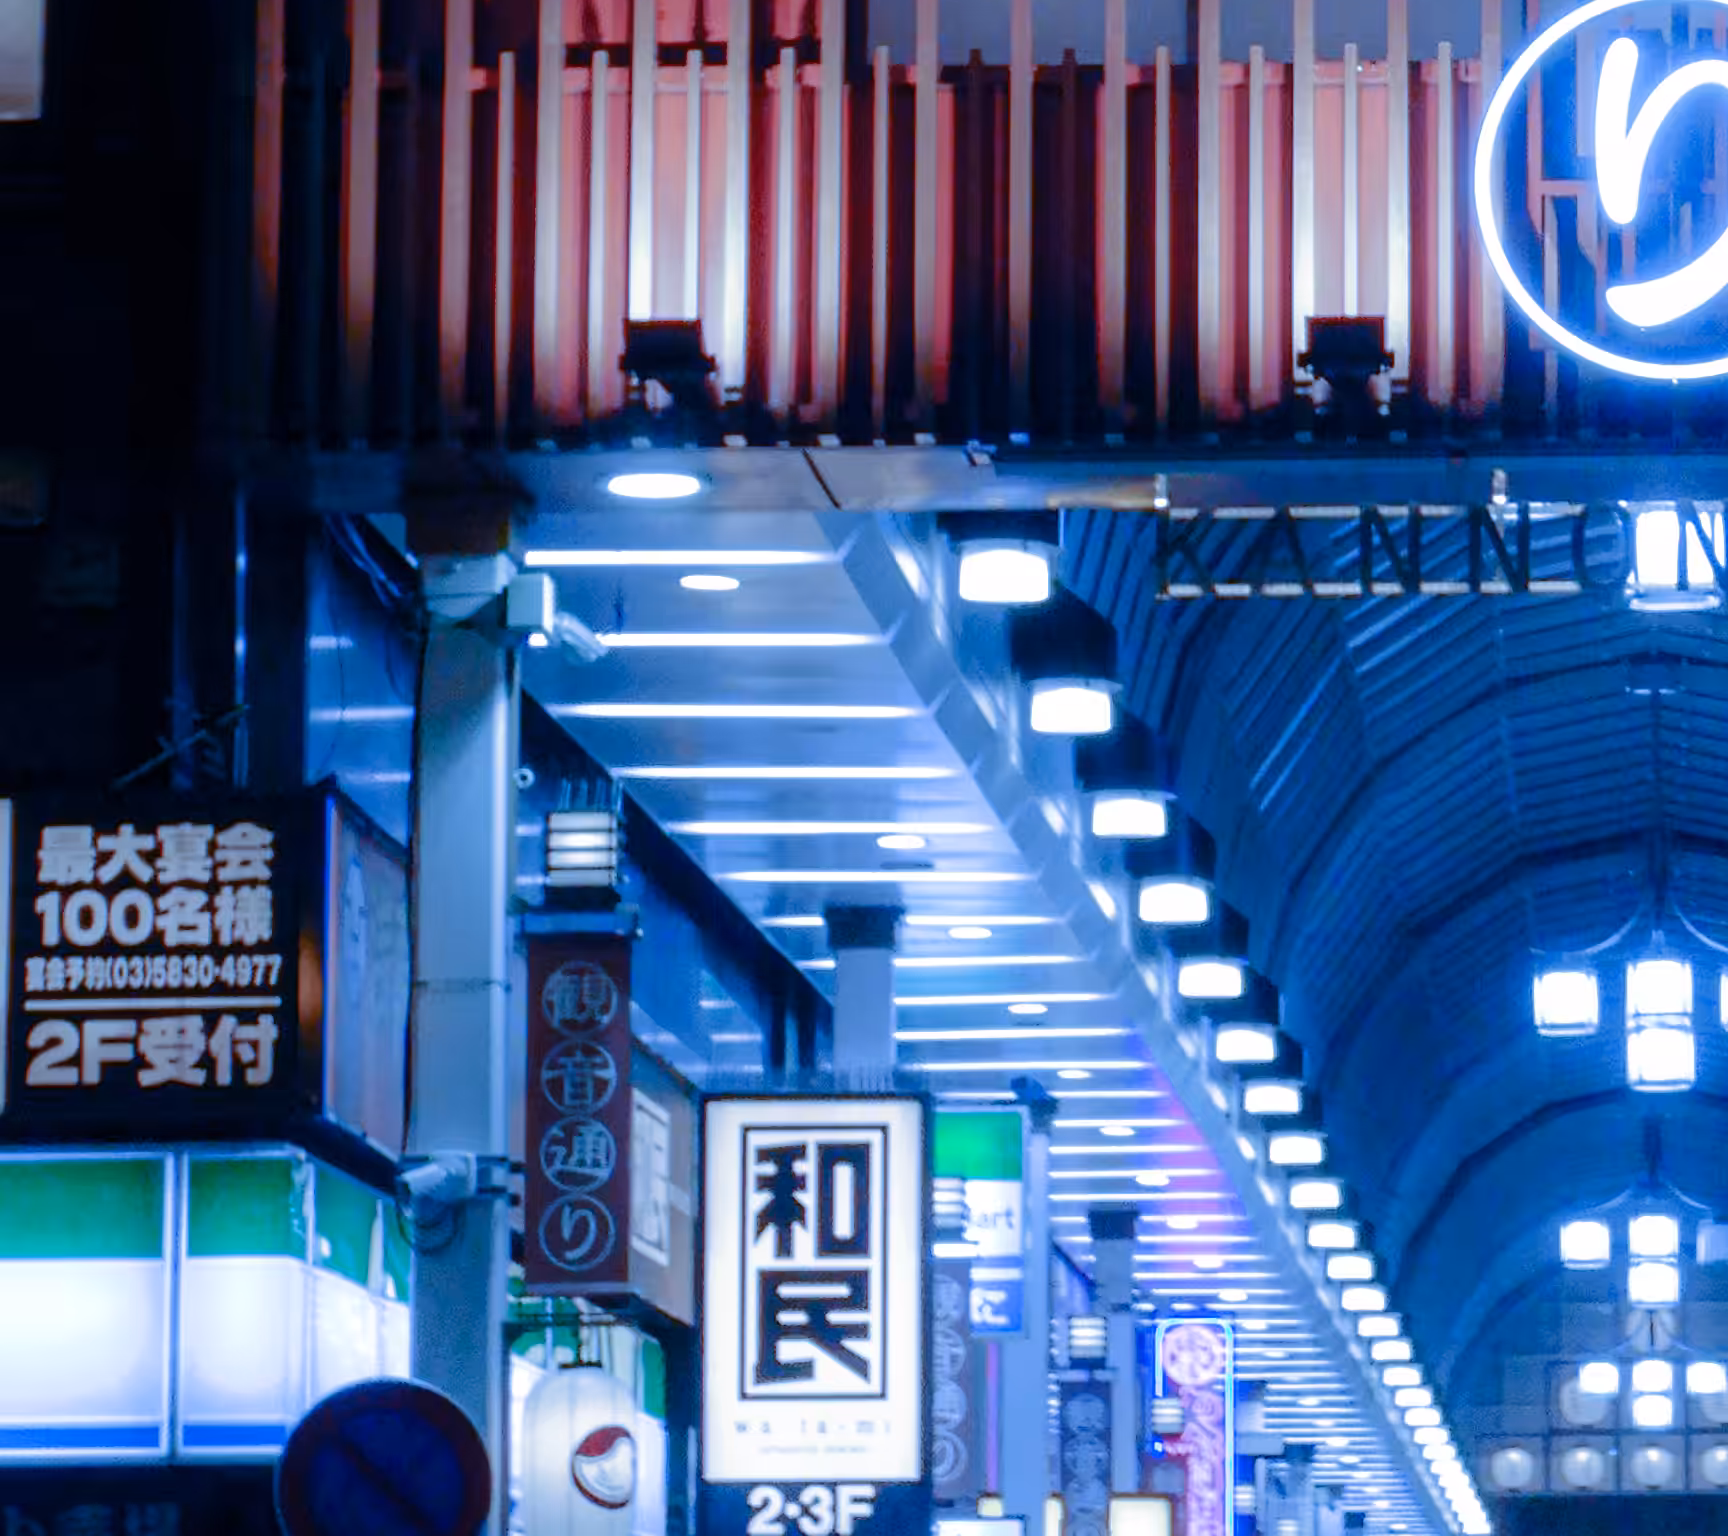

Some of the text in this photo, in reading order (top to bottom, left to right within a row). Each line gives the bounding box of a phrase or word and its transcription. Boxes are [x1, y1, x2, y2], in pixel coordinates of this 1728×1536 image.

[1154, 498, 1727, 598] KANNON
[38, 822, 275, 885] 最大宴会
[35, 885, 274, 948] 100名様
[26, 1014, 279, 1088] 2F受付
[541, 963, 615, 1266] 観音通り
[754, 1142, 870, 1384] 和民
